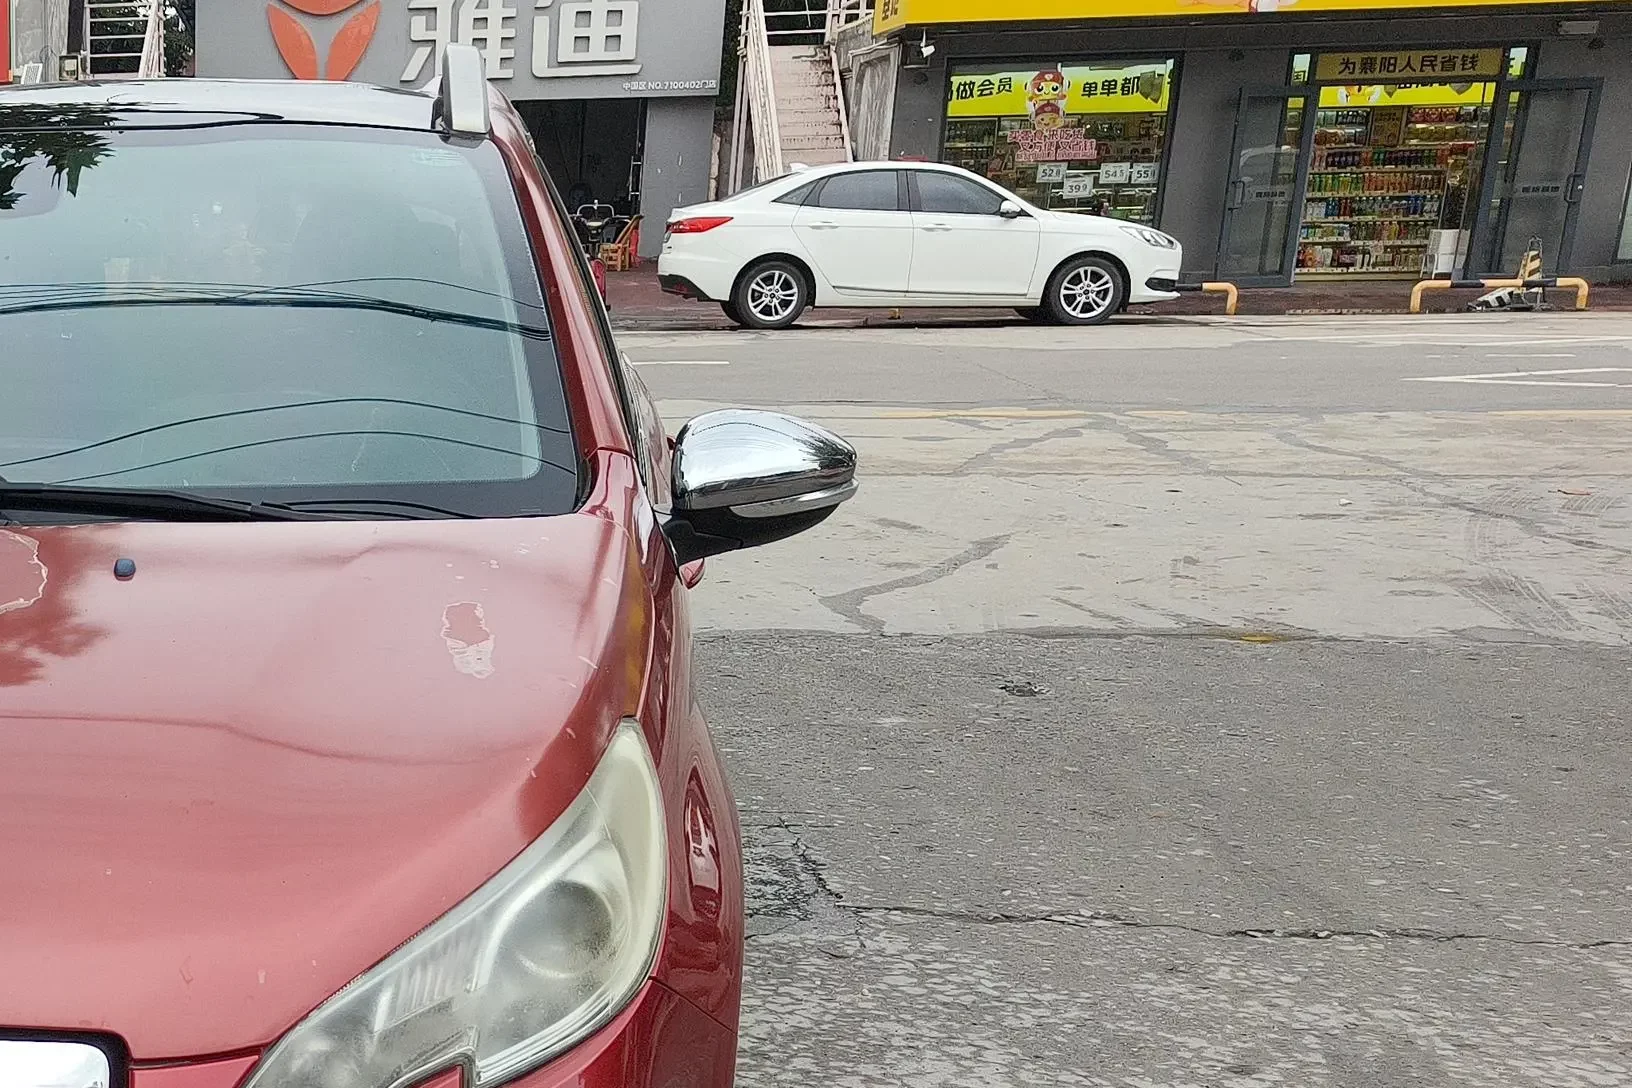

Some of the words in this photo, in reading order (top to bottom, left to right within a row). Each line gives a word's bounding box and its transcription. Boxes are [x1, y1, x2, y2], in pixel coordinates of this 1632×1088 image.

[400, 0, 642, 82] 雅迪
[1339, 54, 1480, 75] 为襄阳人民省钱
[1081, 74, 1165, 98] 单单都
